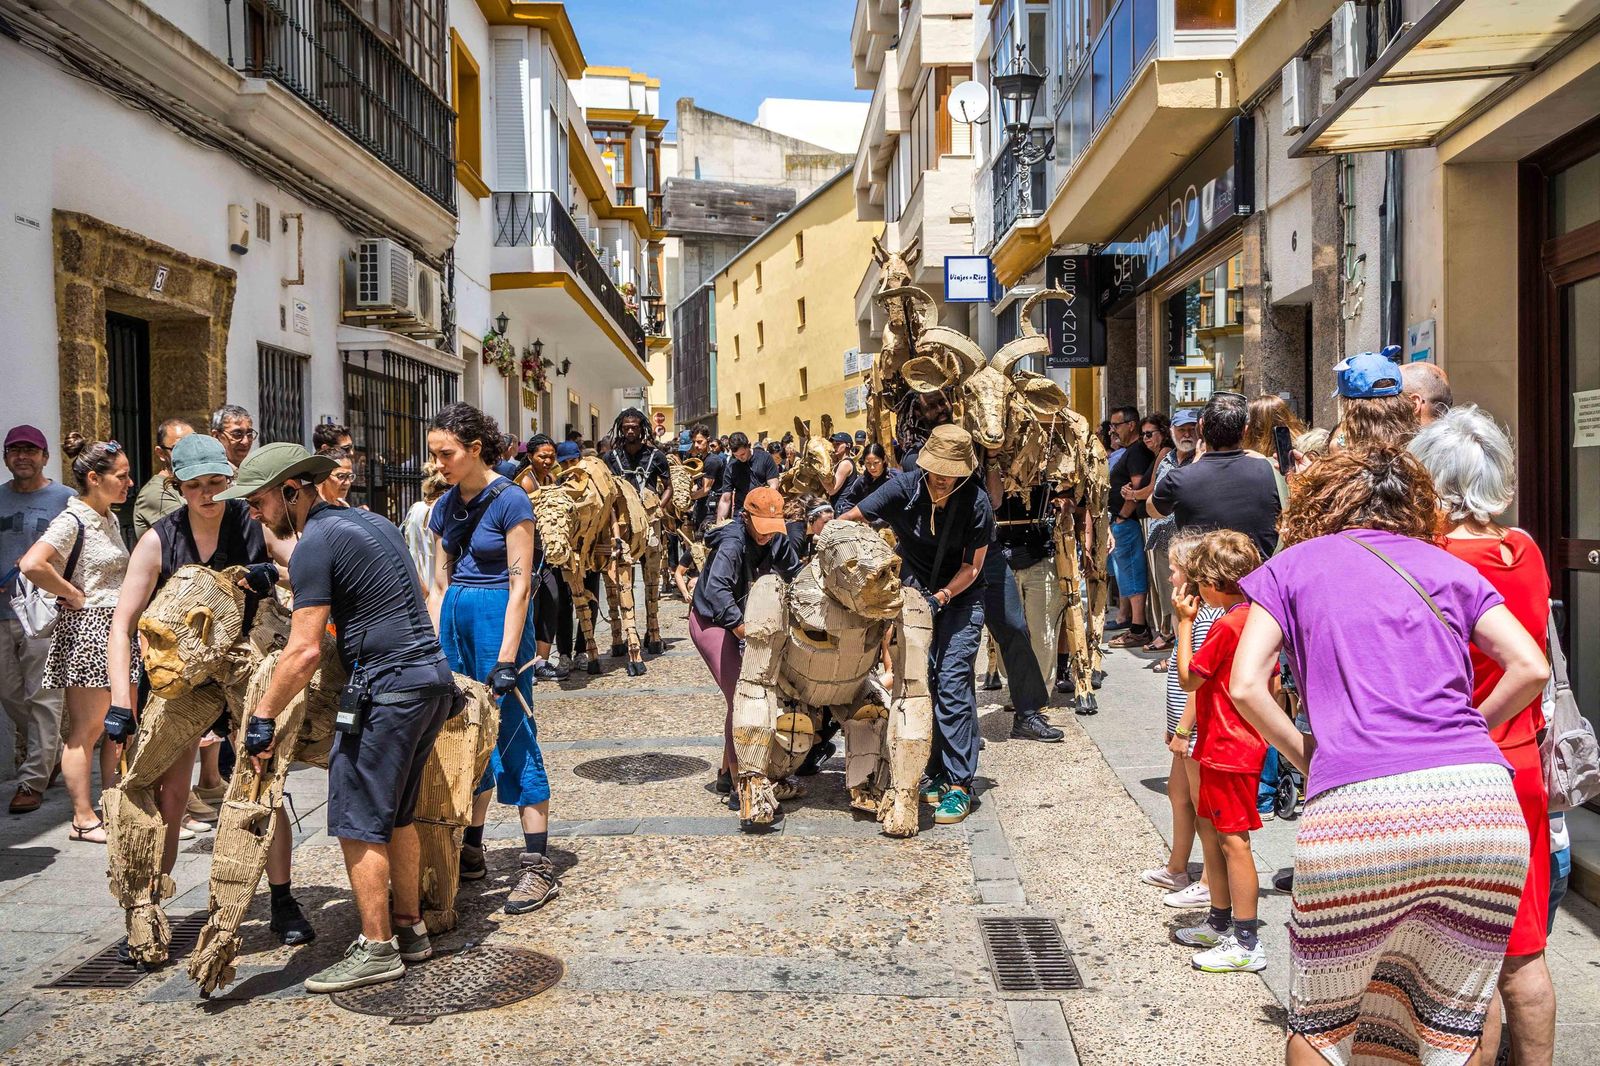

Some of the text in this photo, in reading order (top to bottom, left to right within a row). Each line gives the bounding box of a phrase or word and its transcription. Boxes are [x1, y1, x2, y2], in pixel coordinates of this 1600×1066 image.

[1291, 230, 1298, 252] 6
[950, 273, 968, 281] Viajes
[1062, 259, 1077, 355] SERVANDO
